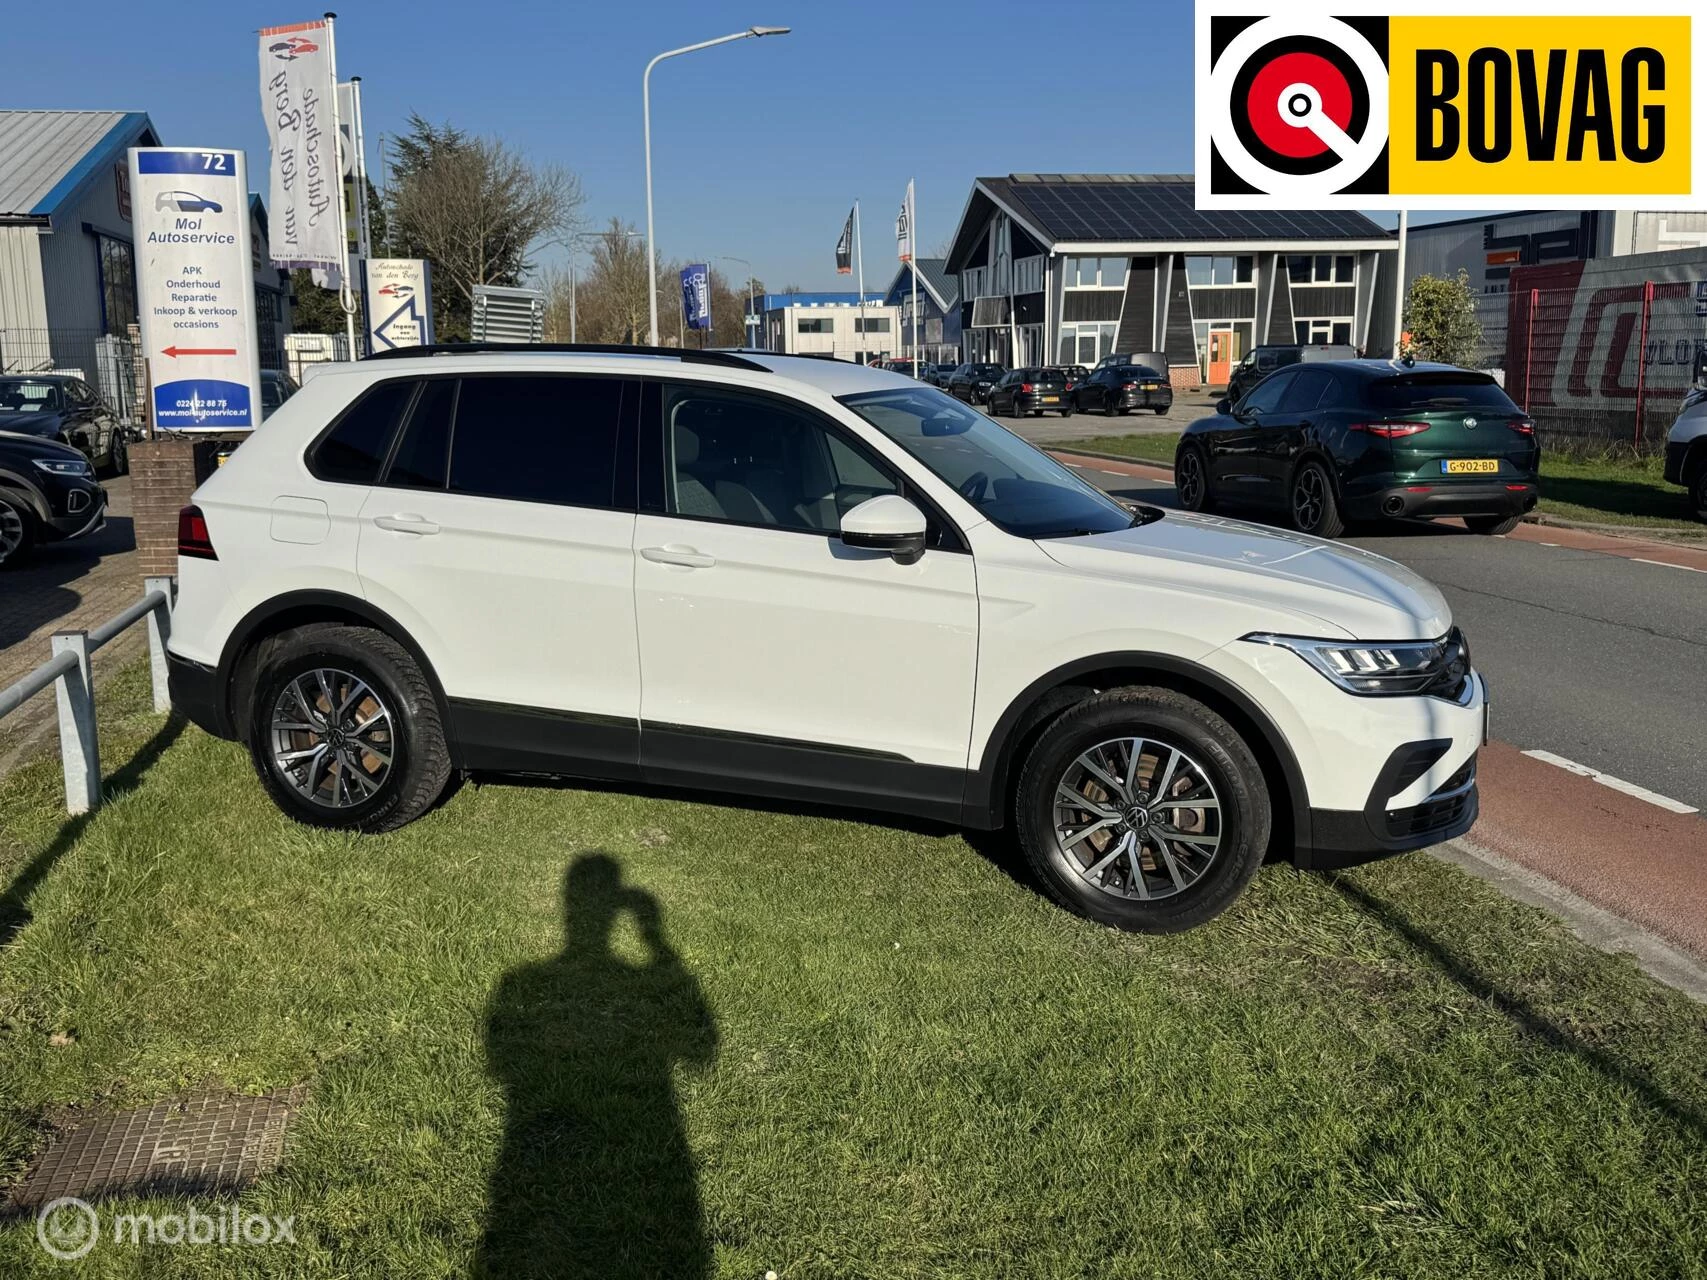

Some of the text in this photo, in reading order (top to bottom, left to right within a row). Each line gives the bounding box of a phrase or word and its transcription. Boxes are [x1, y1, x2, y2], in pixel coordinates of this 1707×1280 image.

[201, 153, 227, 171] 72
[175, 217, 203, 230] Mol
[147, 231, 236, 245] Autoservice
[182, 266, 203, 276] APK
[166, 279, 221, 290] Onderhoud
[171, 292, 218, 304] Reparatie
[154, 306, 238, 319] Inkoop & verkoop
[173, 320, 220, 329] occasions
[1449, 461, 1496, 472] G-902-BD
